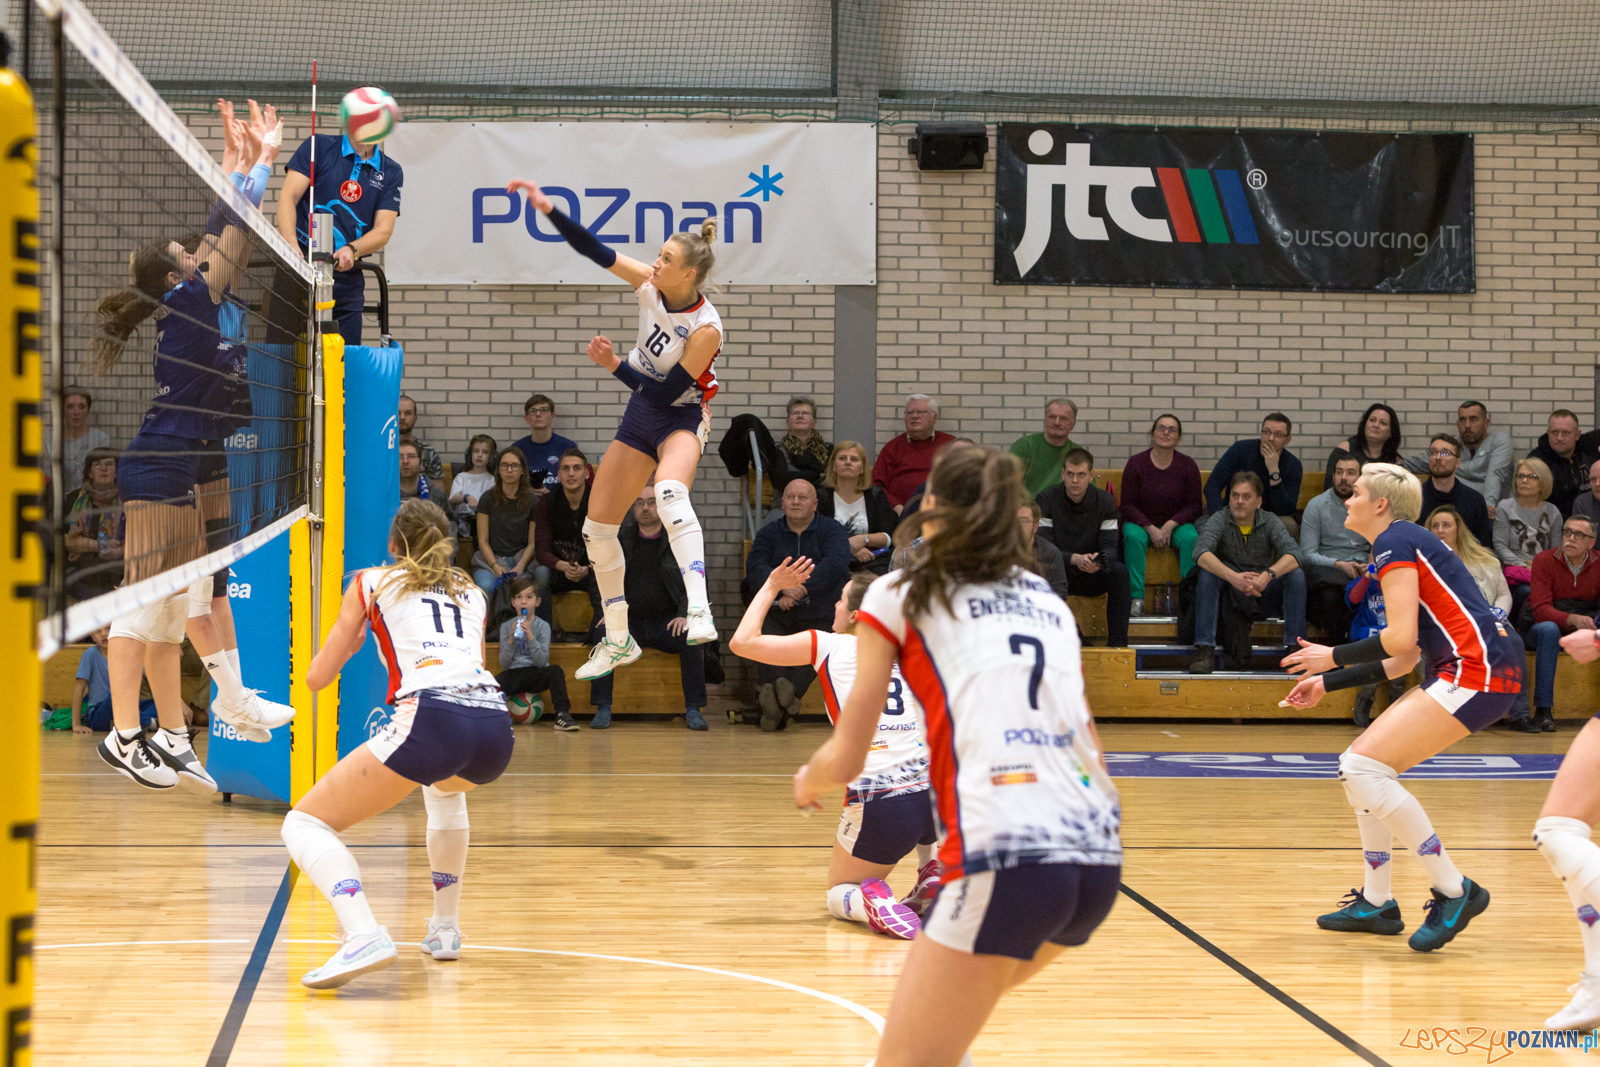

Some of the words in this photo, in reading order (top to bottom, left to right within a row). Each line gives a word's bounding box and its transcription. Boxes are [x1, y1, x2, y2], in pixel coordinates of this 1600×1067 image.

[1013, 130, 1173, 278] jtc
[1278, 228, 1428, 256] outsourcing
[1439, 225, 1461, 248] IT
[645, 323, 671, 357] 16
[421, 597, 464, 639] 11
[1009, 634, 1045, 710] 7
